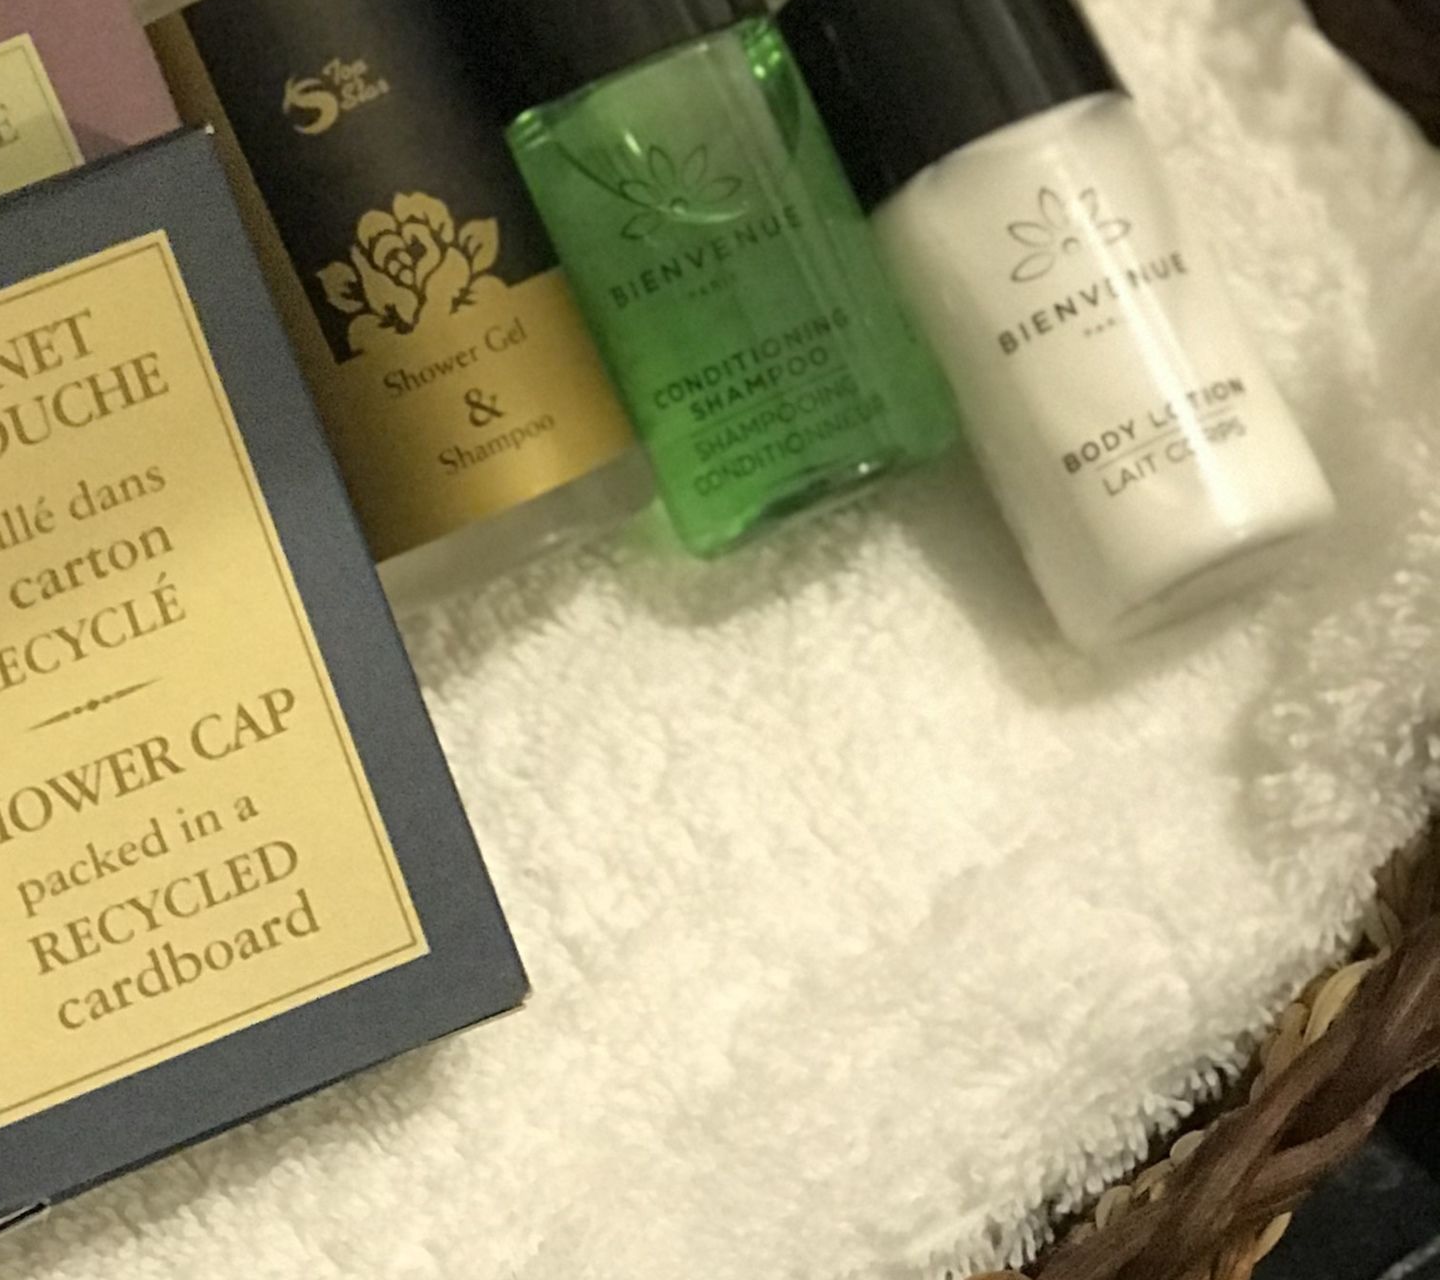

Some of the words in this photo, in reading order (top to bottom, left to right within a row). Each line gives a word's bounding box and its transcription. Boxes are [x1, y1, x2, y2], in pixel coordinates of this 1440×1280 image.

[610, 204, 801, 310] BIENVENUE
[383, 345, 479, 399] Shower
[484, 316, 528, 353] Gel
[653, 307, 849, 410] CONDITIONING
[689, 345, 828, 421] SHAMPOO
[438, 412, 556, 476] Shampoo
[464, 387, 505, 428] &
[694, 372, 860, 463] SHAMPOOING
[1062, 419, 1136, 475] BODY
[67, 465, 167, 521] dans
[1102, 451, 1158, 497] LAIT
[8, 525, 175, 610] carton
[189, 687, 297, 762] CAP
[16, 817, 171, 919] packed
[176, 807, 224, 844] in
[236, 794, 261, 823] a
[26, 840, 300, 976] RECYCLED
[57, 887, 322, 1031] cardboard
